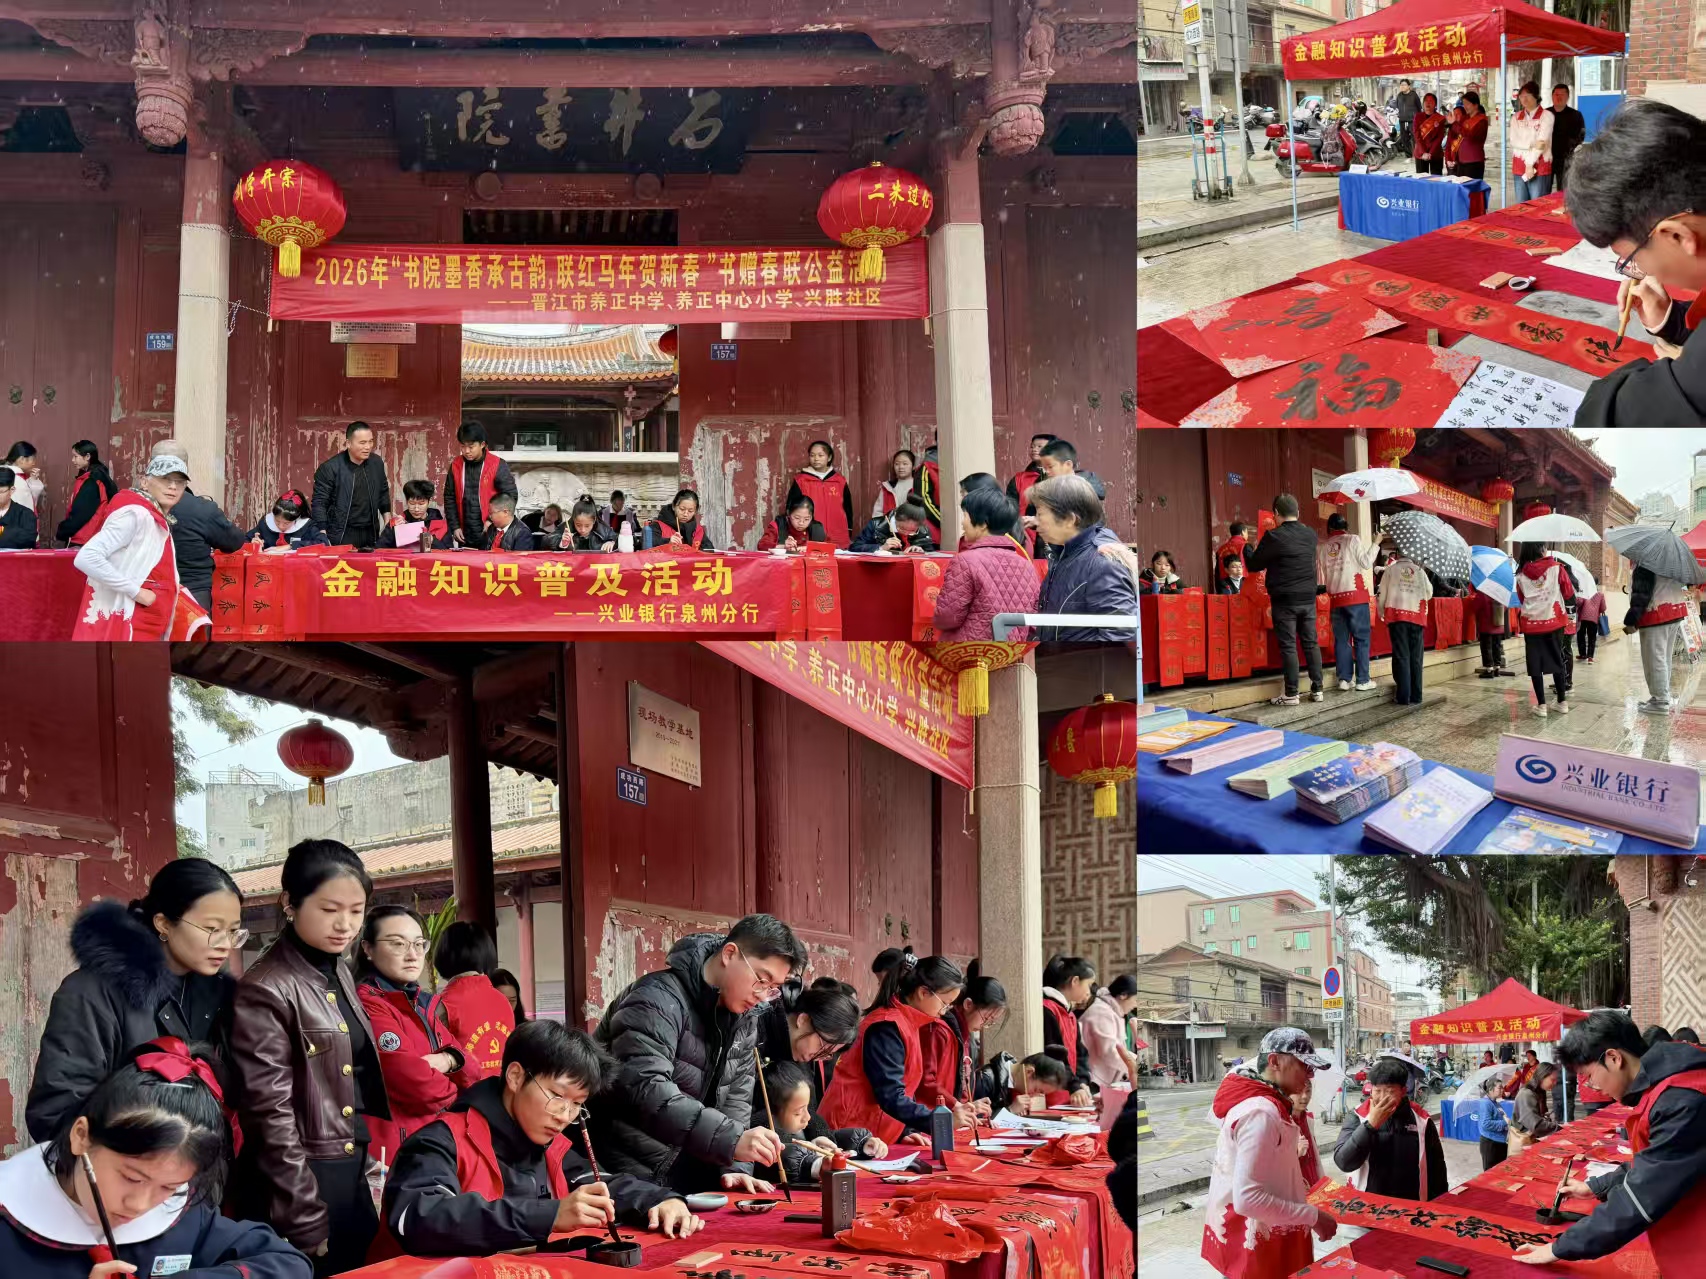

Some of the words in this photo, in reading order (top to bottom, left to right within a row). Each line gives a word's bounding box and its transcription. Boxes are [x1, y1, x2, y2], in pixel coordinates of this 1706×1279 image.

[1295, 21, 1467, 62] 金融知识普及活动
[1274, 353, 1402, 420] 福
[321, 558, 733, 598] 金融知识普及活动
[1561, 784, 1605, 800] INDUSTRIAL
[1563, 762, 1670, 803] 兴业银行
[1419, 1016, 1541, 1035] 金融知识普及活动
